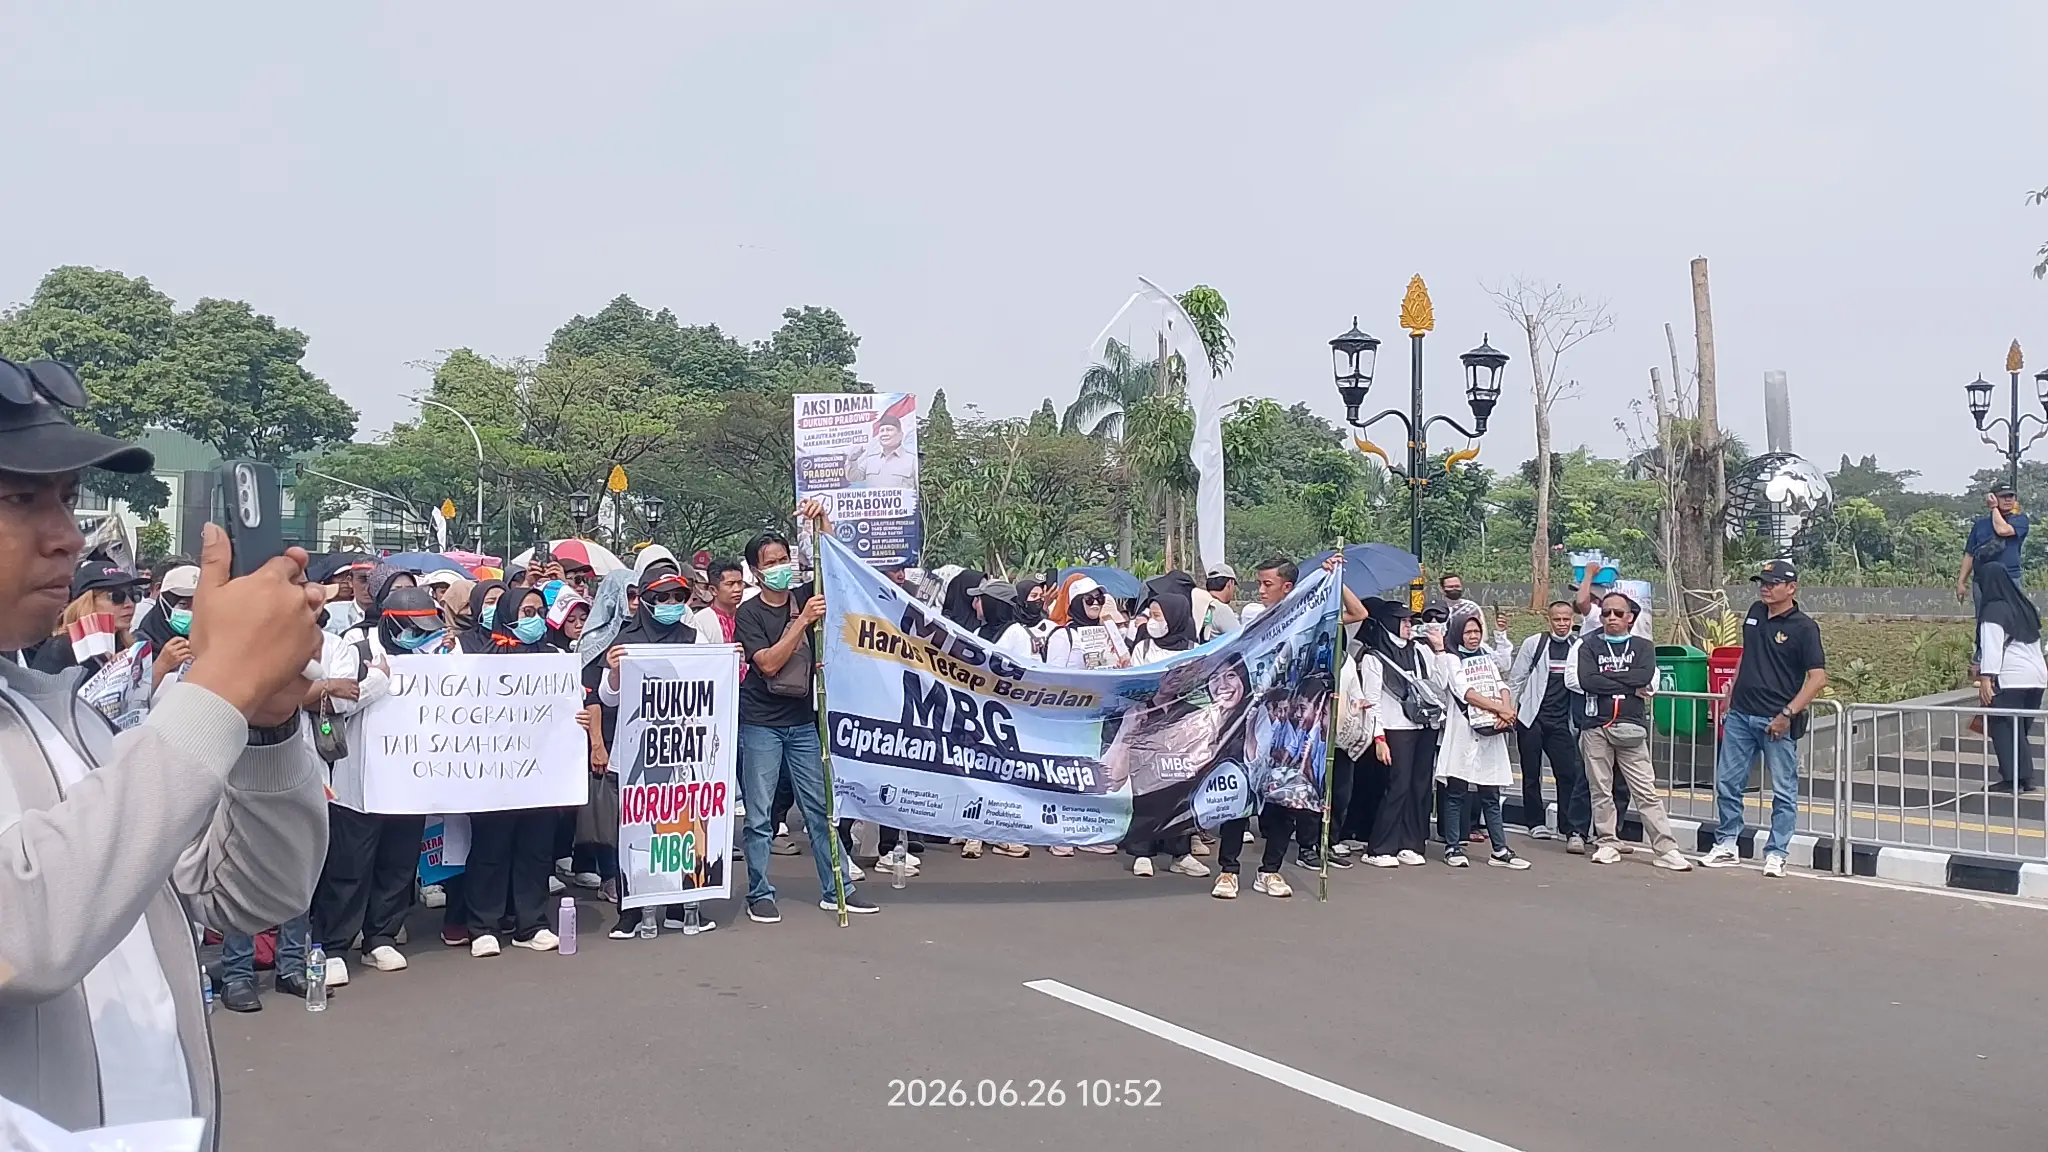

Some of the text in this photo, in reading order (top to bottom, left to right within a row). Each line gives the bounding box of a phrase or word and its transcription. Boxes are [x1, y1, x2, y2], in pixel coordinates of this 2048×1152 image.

[802, 396, 873, 416] AKSI DAMAI
[802, 412, 871, 428] DUKUNG PRABOWO
[837, 429, 863, 437] PROGRAM
[853, 435, 868, 444] MBG
[803, 468, 844, 479] PRABOWO
[837, 490, 902, 499] DUKUNG PRESIDEN
[838, 497, 902, 511] PRABOWO
[838, 510, 887, 518] BERSIH-BERSIH
[872, 549, 896, 557] BANGSA
[901, 602, 1027, 680] MBG
[858, 619, 1093, 707] Harus Tetap Berjalan
[1465, 665, 1493, 675] DAMAI
[1467, 658, 1486, 667] AKSI
[84, 674, 100, 694] AKSI
[387, 673, 579, 697] JANGAN SALAHKAN
[641, 679, 714, 718] HUKUM
[901, 670, 1020, 755] MBG
[382, 733, 531, 755] TAPI SALAHKAN
[646, 726, 707, 766] BERAT
[836, 718, 1095, 791] Ciptakan Lapangan Kerja
[413, 758, 543, 779] OKNUMNYA
[1161, 757, 1192, 771] MBG
[1206, 775, 1238, 793] MBG
[901, 788, 939, 799] Menguatkan
[622, 782, 726, 825] KORUPTOR
[900, 797, 943, 809] Ekonomi Lokal
[910, 808, 936, 817] Nasional
[1098, 817, 1115, 825] Depan
[421, 834, 443, 852] BERA
[650, 833, 695, 873] MBG
